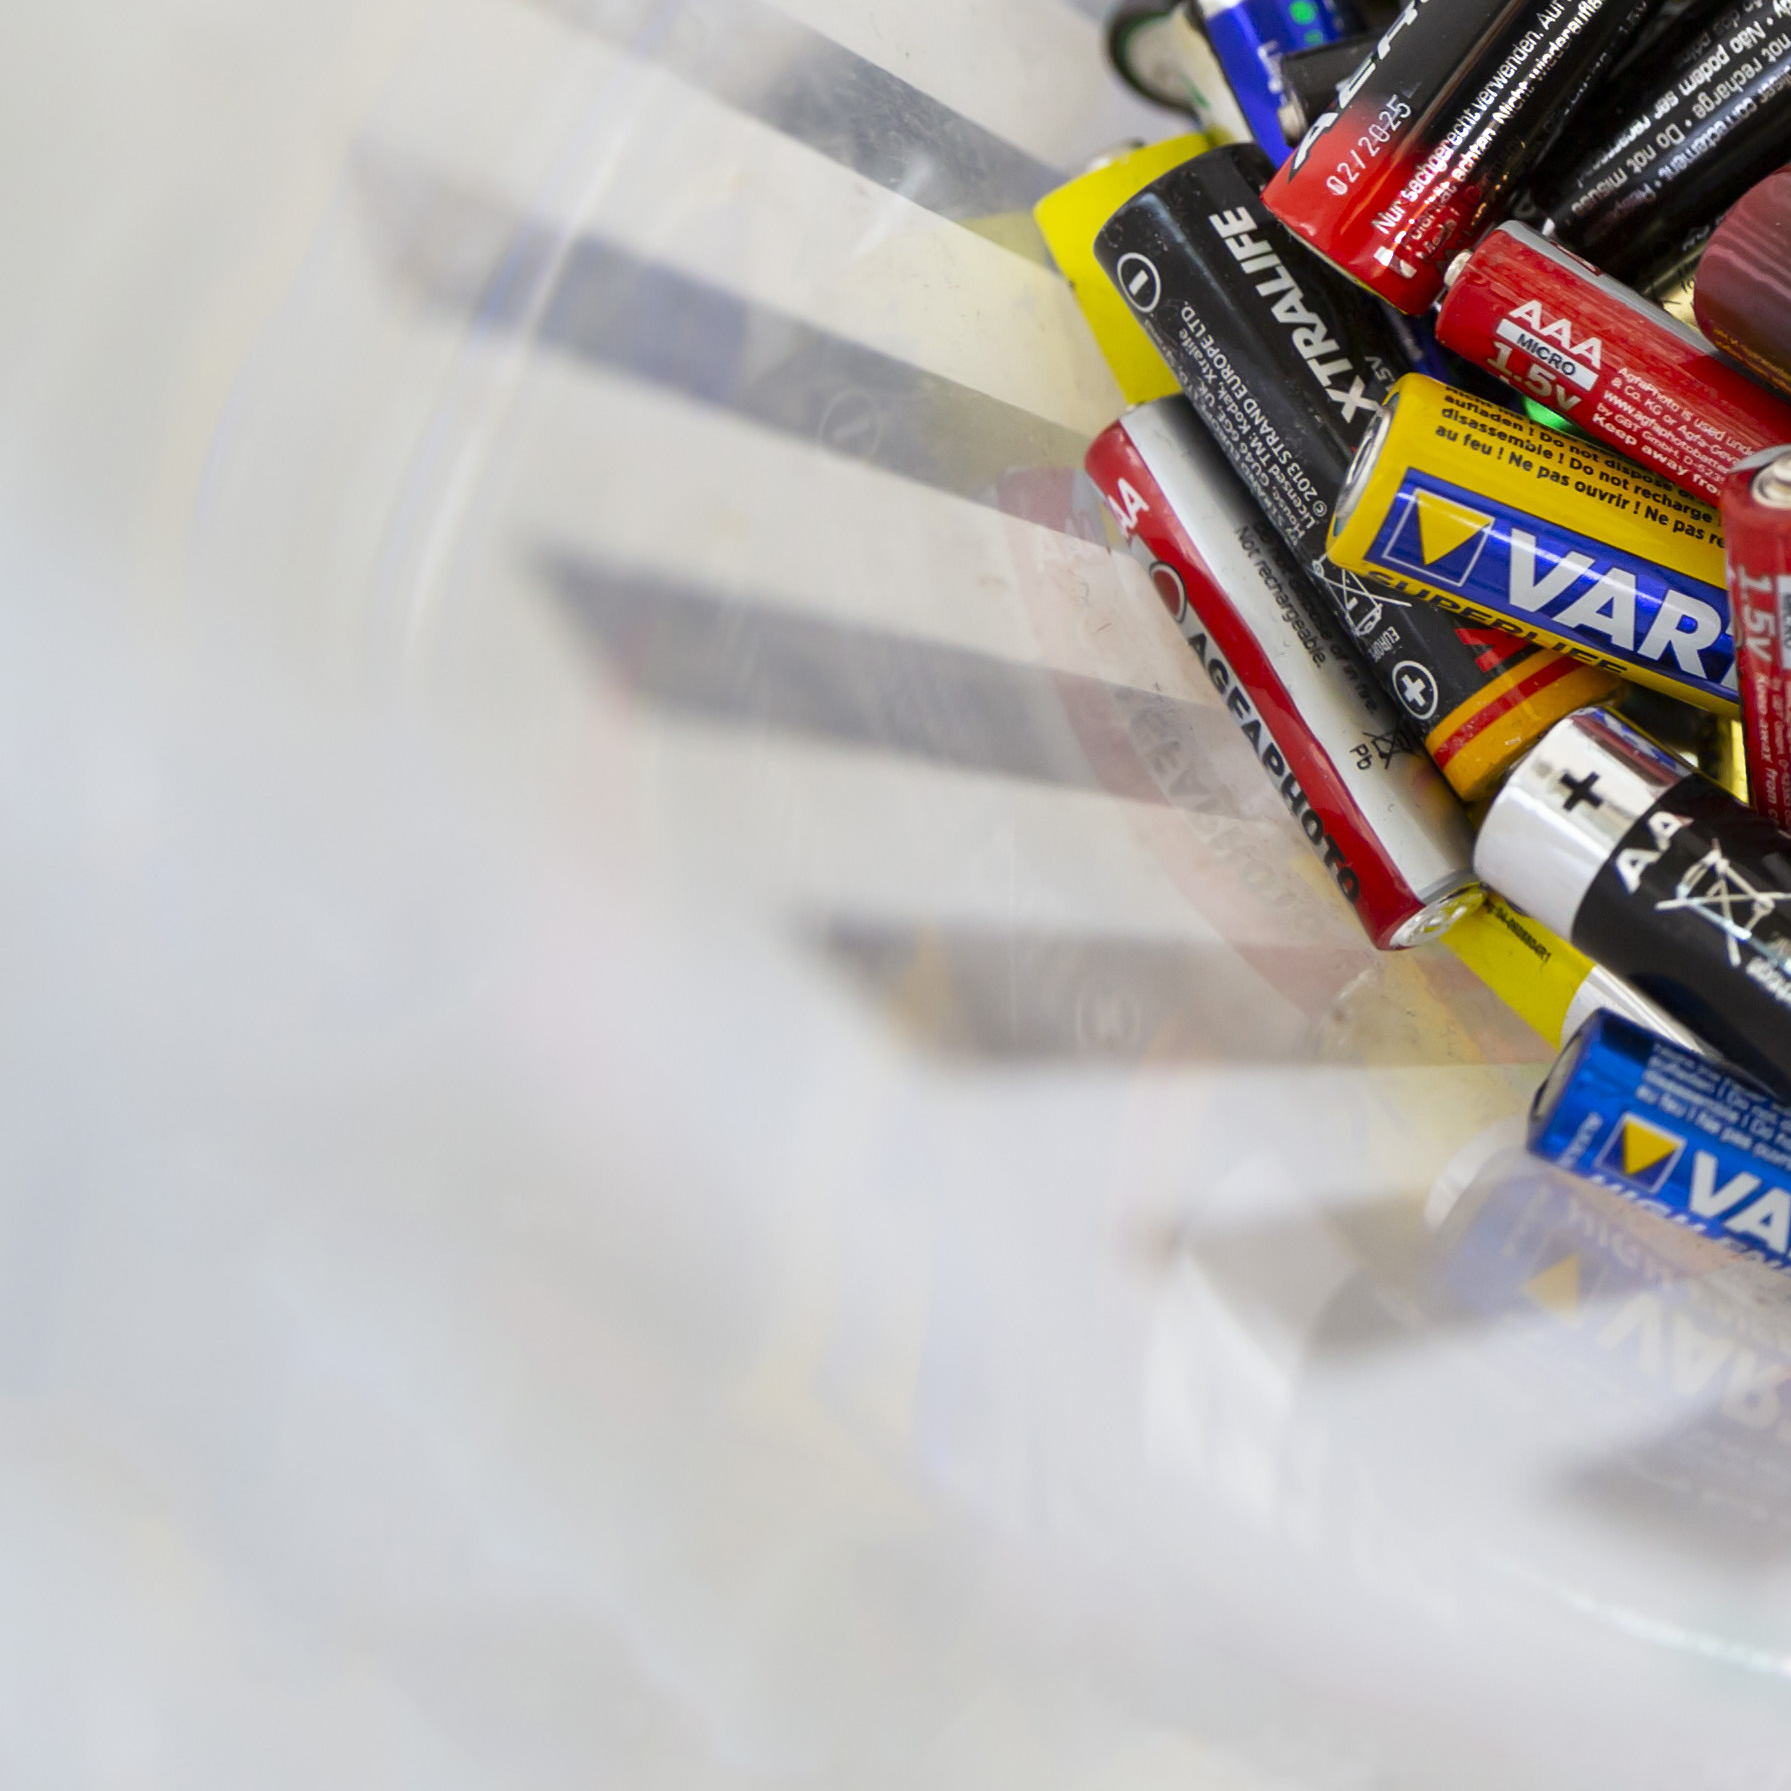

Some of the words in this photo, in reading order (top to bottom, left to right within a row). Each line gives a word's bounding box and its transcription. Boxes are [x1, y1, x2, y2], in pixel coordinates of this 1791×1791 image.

[1325, 98, 1411, 197] 02/2025
[1173, 299, 1208, 338] LTD.
[1209, 204, 1377, 426] XTRALIFE
[1508, 300, 1605, 367] AAA
[1173, 327, 1220, 383] Xtralife
[1196, 334, 1250, 400] EUROPE
[1514, 333, 1578, 376] MICRO
[1210, 379, 1256, 434] Kodak,
[1239, 396, 1294, 464] STRAND
[1245, 431, 1275, 465] TM:
[1284, 461, 1319, 501] 2013
[1440, 405, 1554, 461] disassemble
[1568, 457, 1596, 477] Do
[1597, 469, 1630, 491] not
[1631, 482, 1714, 527] recharge
[1265, 462, 1319, 528] Licensed
[1434, 423, 1459, 442] au
[1461, 432, 1495, 457] feu
[1506, 450, 1535, 472] Ne
[1536, 464, 1572, 491] pas
[1572, 476, 1631, 511] ouvrir
[1643, 504, 1672, 527] Ne
[1671, 518, 1706, 544] pas
[1232, 525, 1262, 559] Not
[1247, 557, 1335, 669] rechargeable.
[1507, 529, 1735, 681] VAR
[1346, 742, 1375, 773] Pb
[1617, 809, 1691, 891] AA
